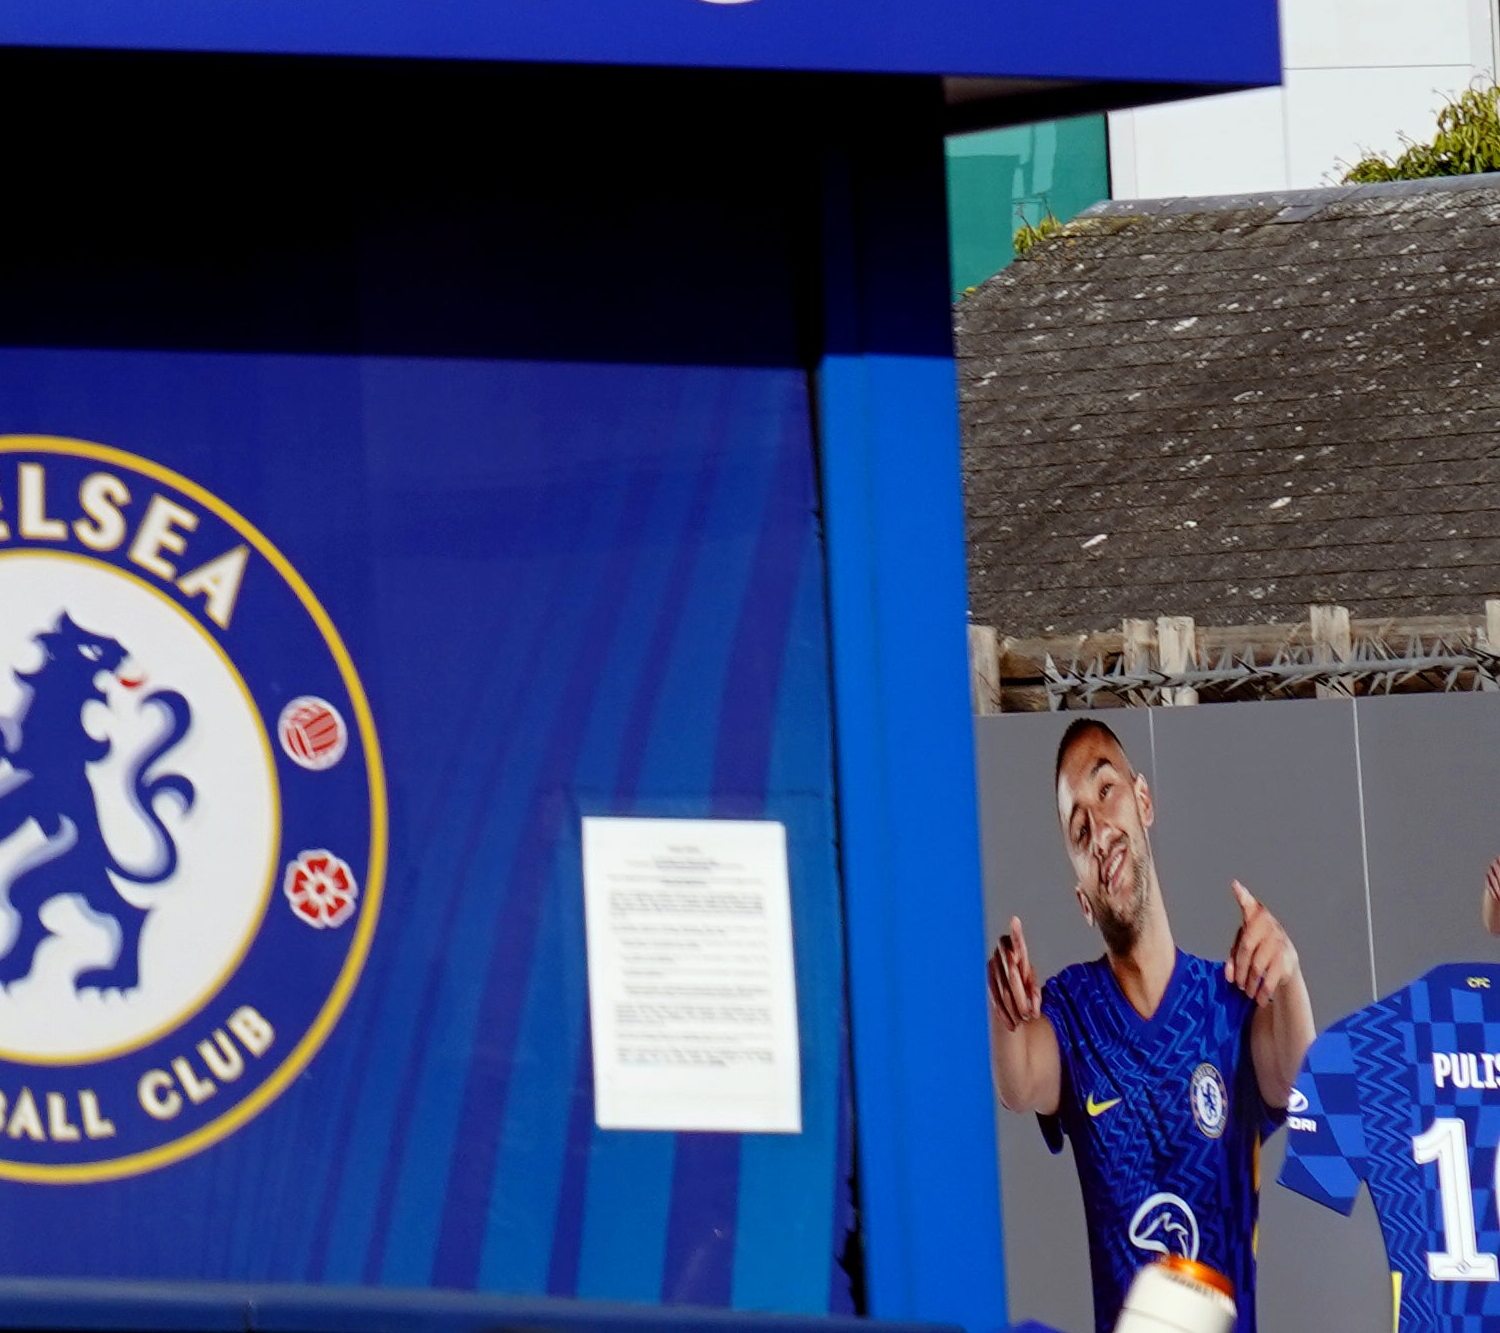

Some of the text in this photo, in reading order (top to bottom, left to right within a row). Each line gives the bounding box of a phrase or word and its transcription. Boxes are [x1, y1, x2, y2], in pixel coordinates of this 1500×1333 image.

[1466, 977, 1490, 988] CFC
[138, 1005, 276, 1120] CLUB
[1412, 1118, 1500, 1281] 1
